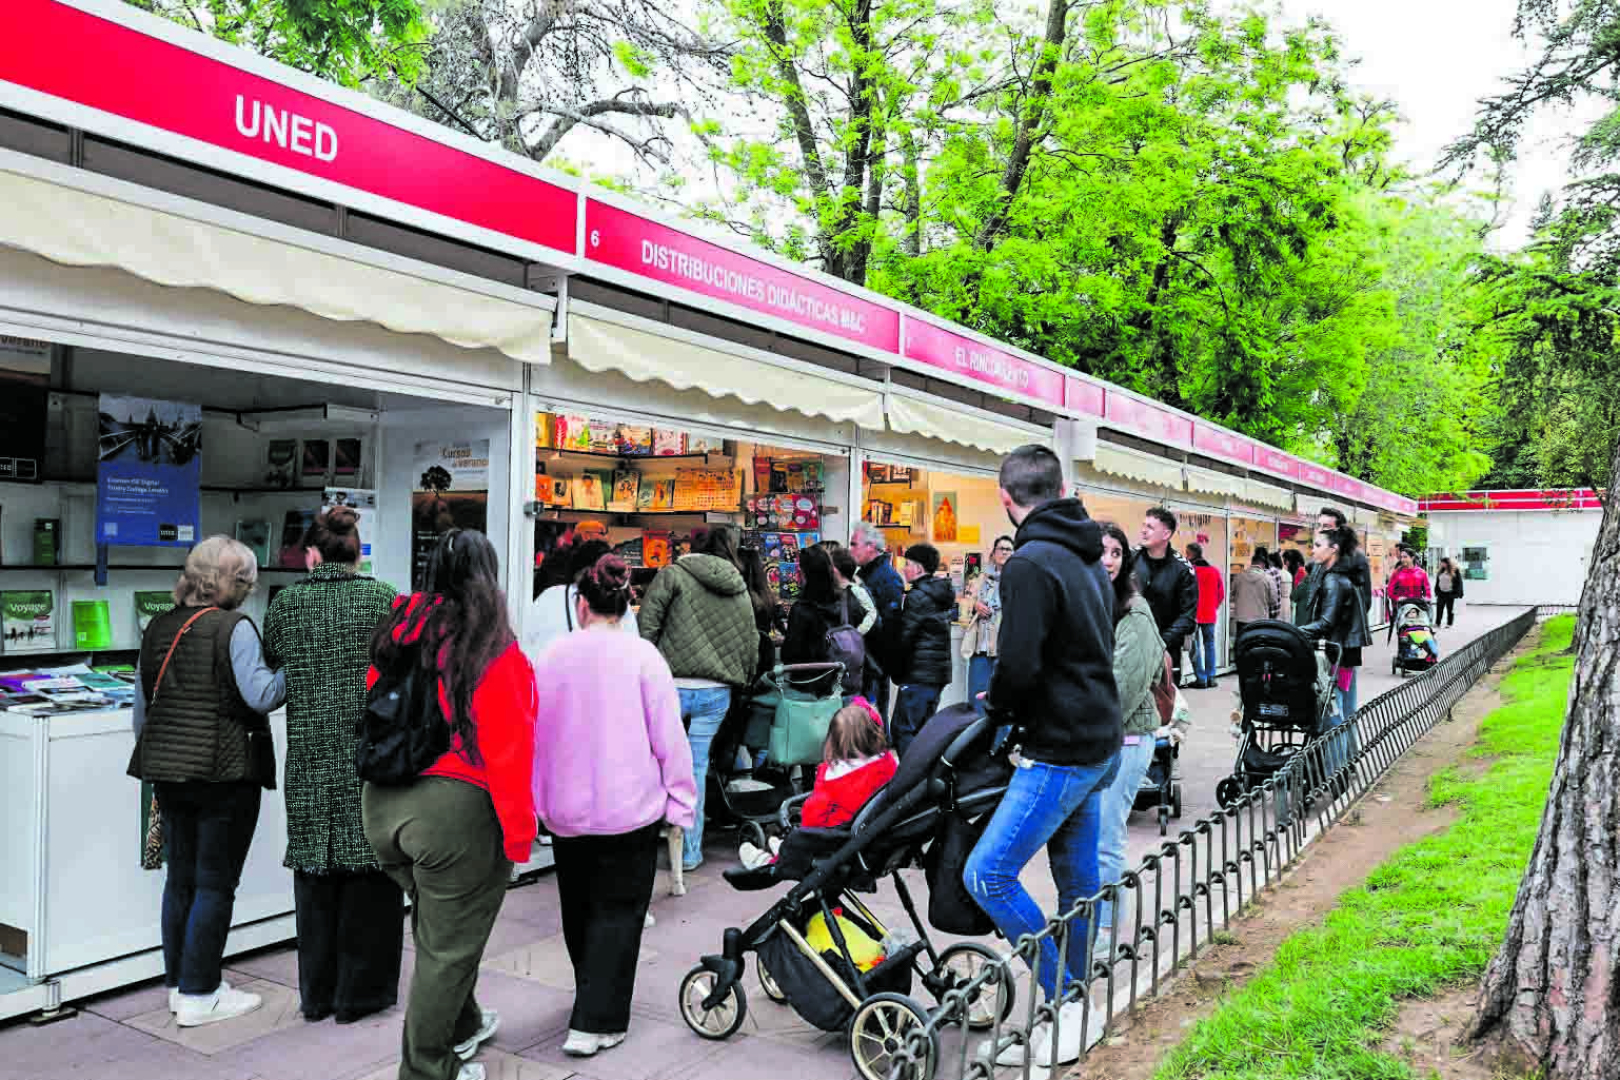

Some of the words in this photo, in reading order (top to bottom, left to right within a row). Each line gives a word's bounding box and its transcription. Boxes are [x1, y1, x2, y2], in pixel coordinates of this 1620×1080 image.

[235, 95, 338, 162] UNED
[590, 230, 600, 247] 6
[641, 239, 766, 303] DISTRIBUCIONES
[10, 602, 47, 613] Voyage
